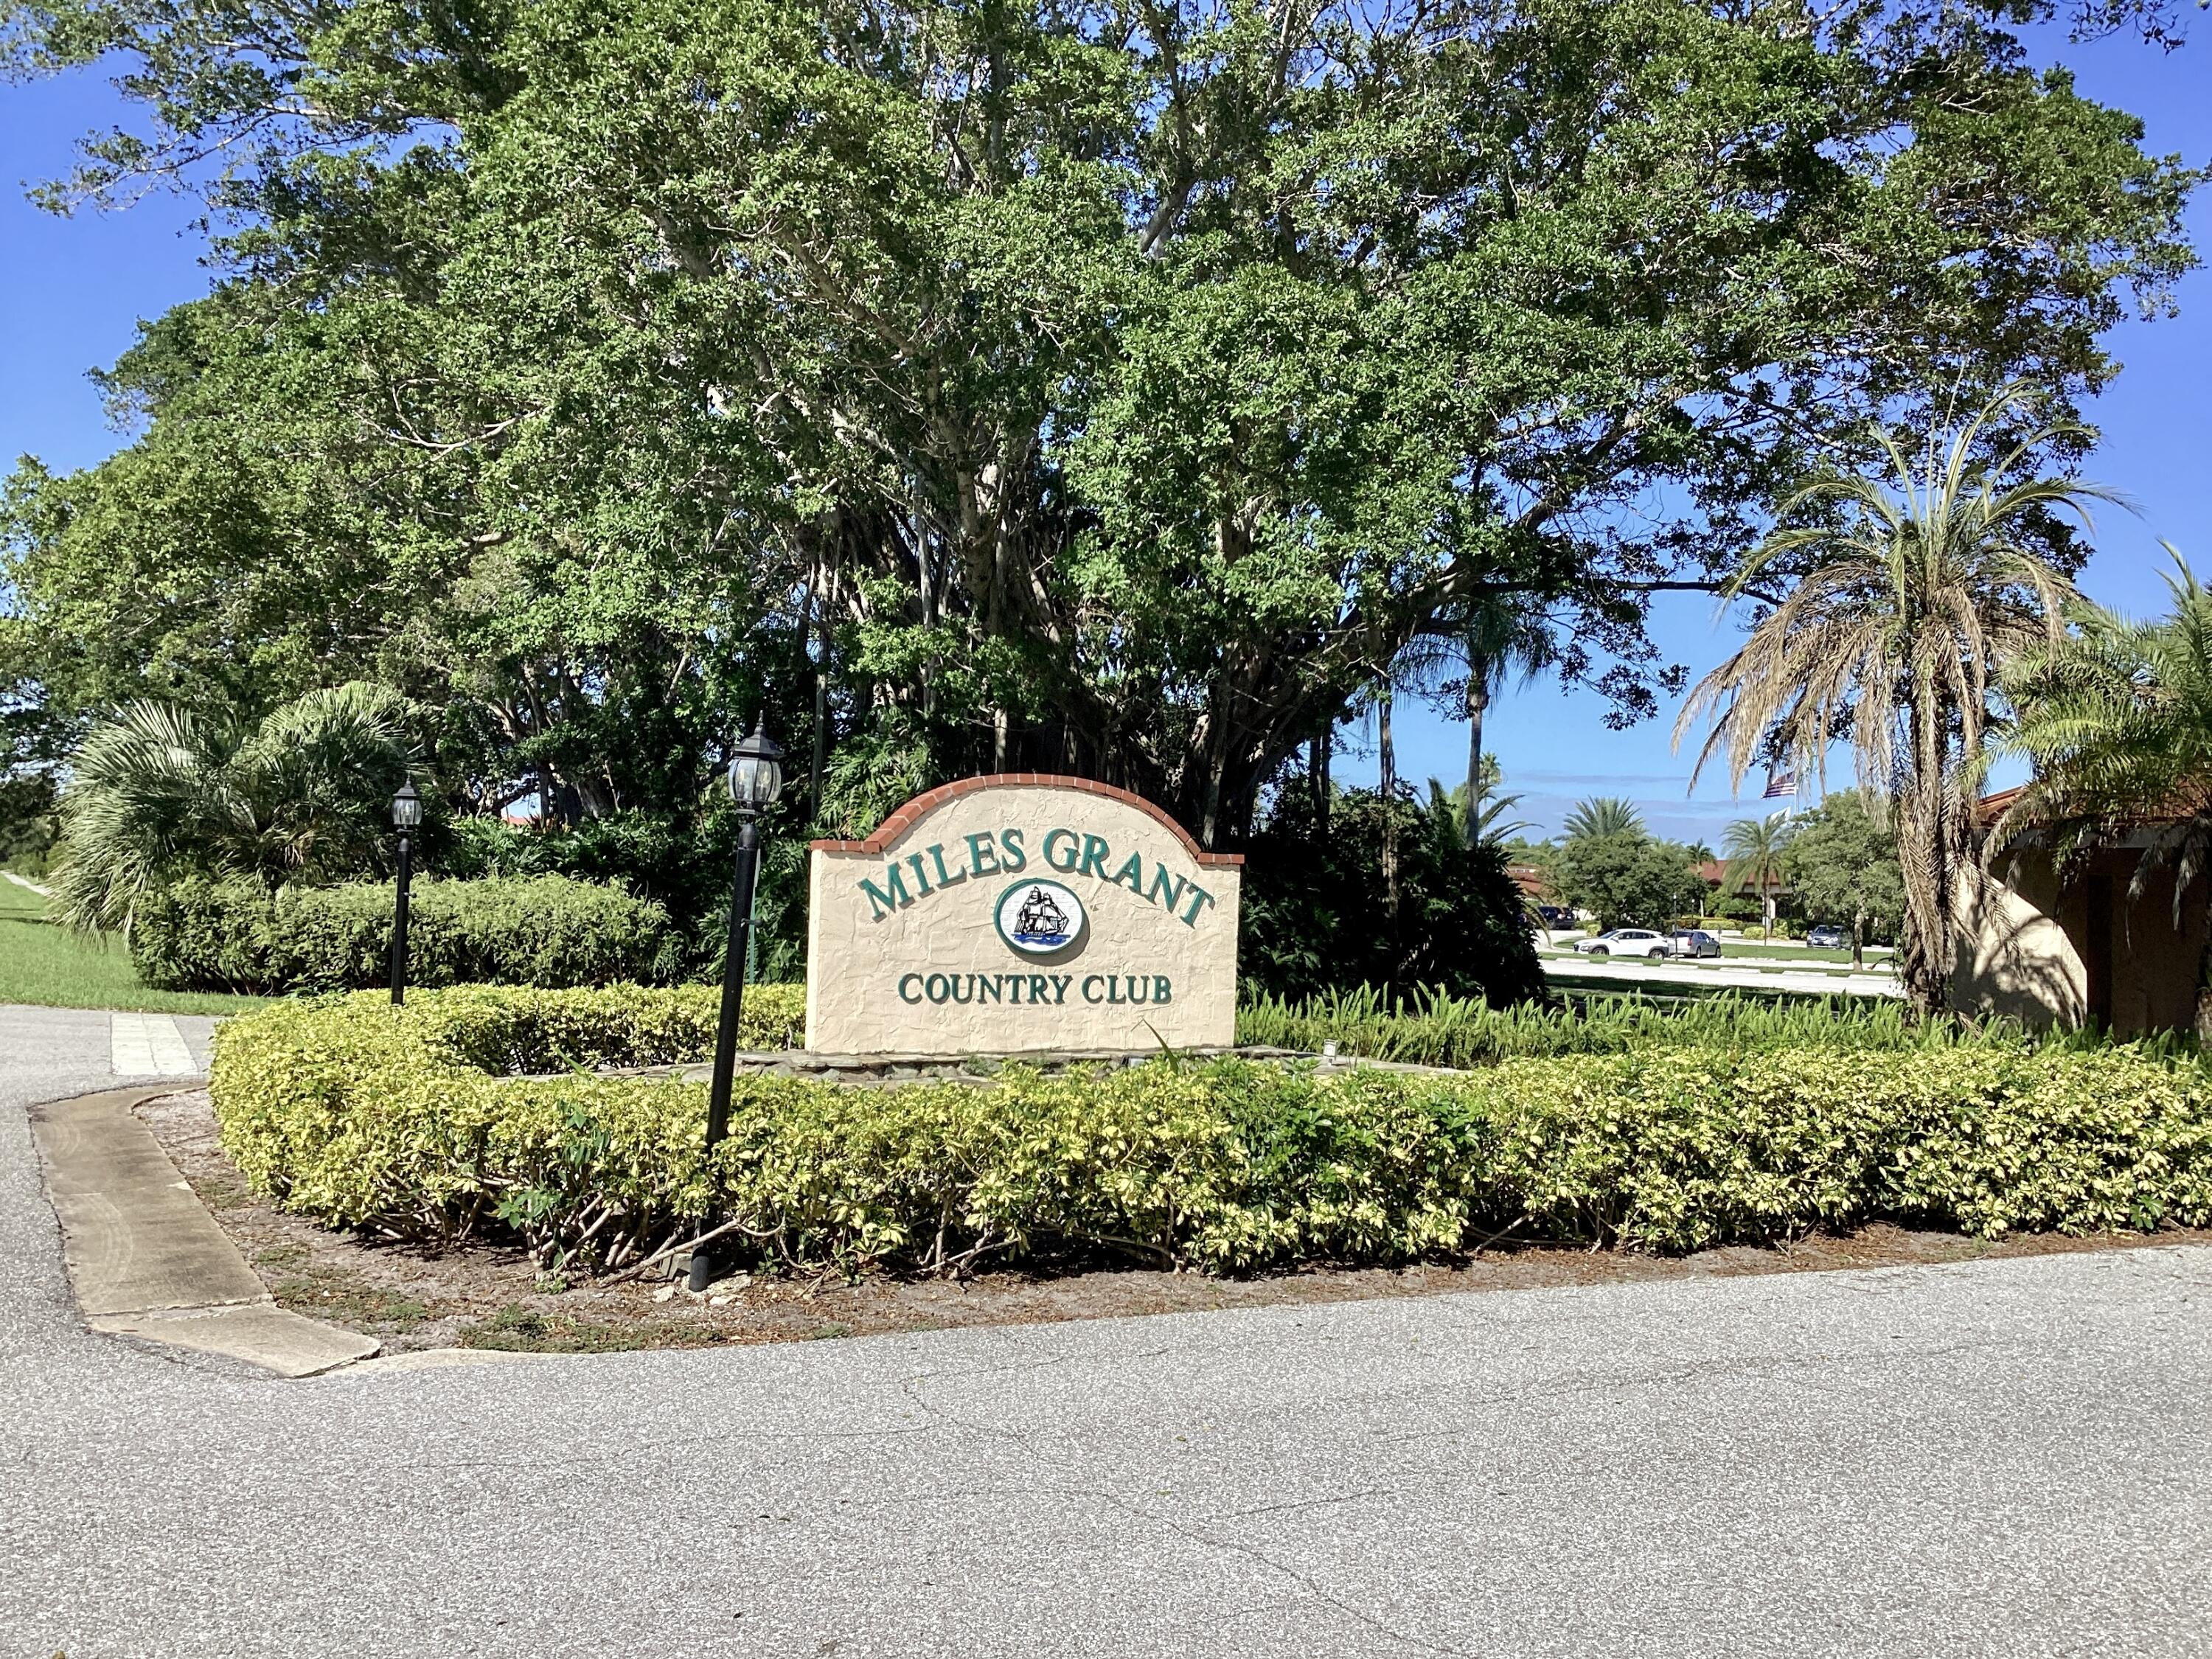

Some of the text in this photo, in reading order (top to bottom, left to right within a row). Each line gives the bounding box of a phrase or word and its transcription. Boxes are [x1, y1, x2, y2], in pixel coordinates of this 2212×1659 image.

[857, 828, 1215, 928] MILES GRANT
[898, 973, 1172, 1005] COUNTRY CLUB
